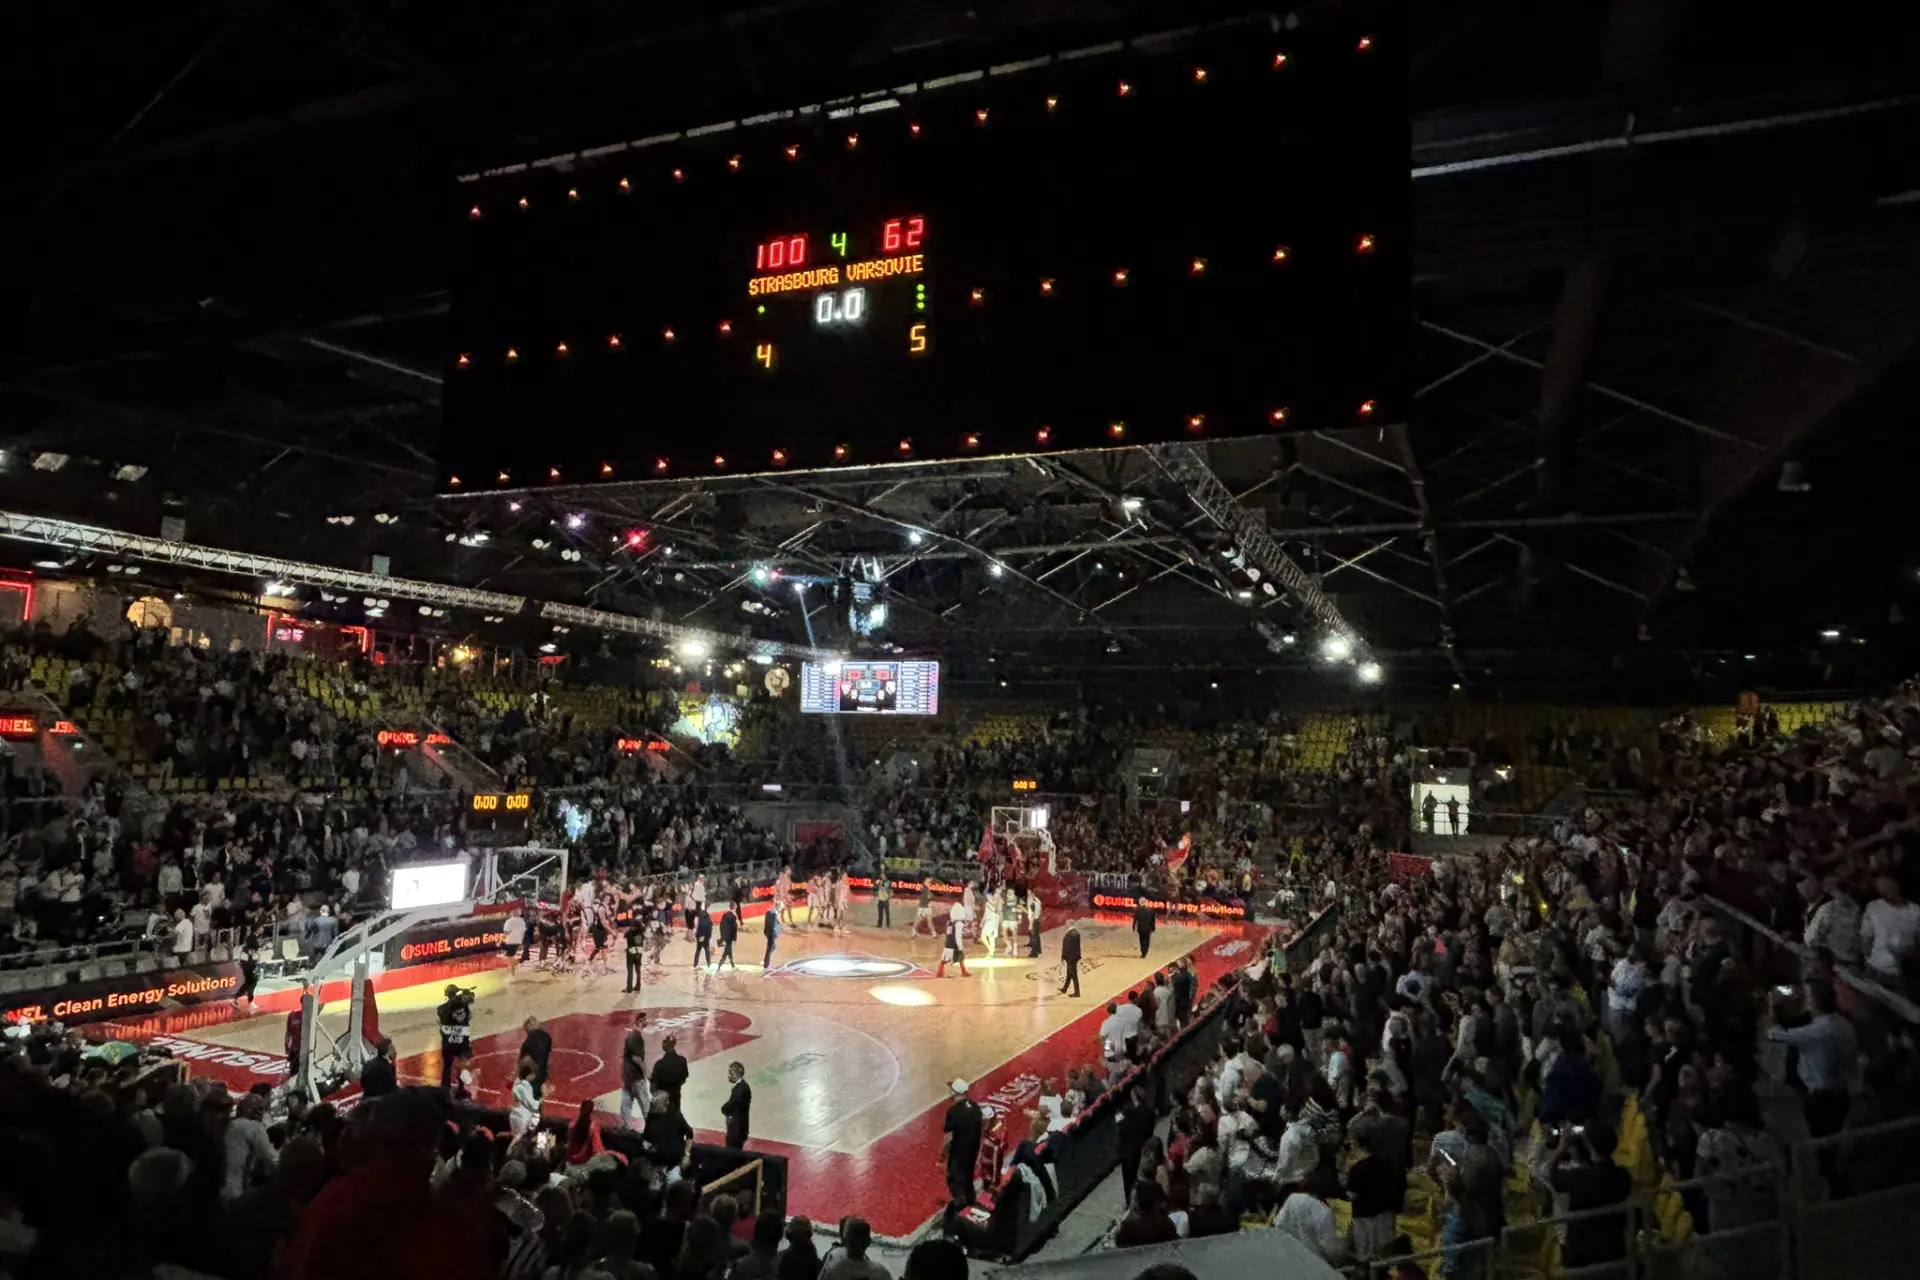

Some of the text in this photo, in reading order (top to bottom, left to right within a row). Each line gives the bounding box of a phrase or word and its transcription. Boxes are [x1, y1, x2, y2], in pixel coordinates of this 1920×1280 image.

[831, 232, 847, 256] 4
[884, 218, 924, 251] 62
[757, 236, 806, 269] 100
[749, 254, 925, 296] STRASBOURG VARSOVIE
[815, 289, 864, 324] 0.0
[910, 324, 926, 351] 5
[757, 343, 772, 369] 4
[1140, 898, 1165, 909] lean
[1200, 903, 1245, 916] Solutions
[414, 939, 452, 957] SUNEL
[454, 935, 480, 949] Clean
[7, 975, 237, 1022] NEL Clean Energy Solutions
